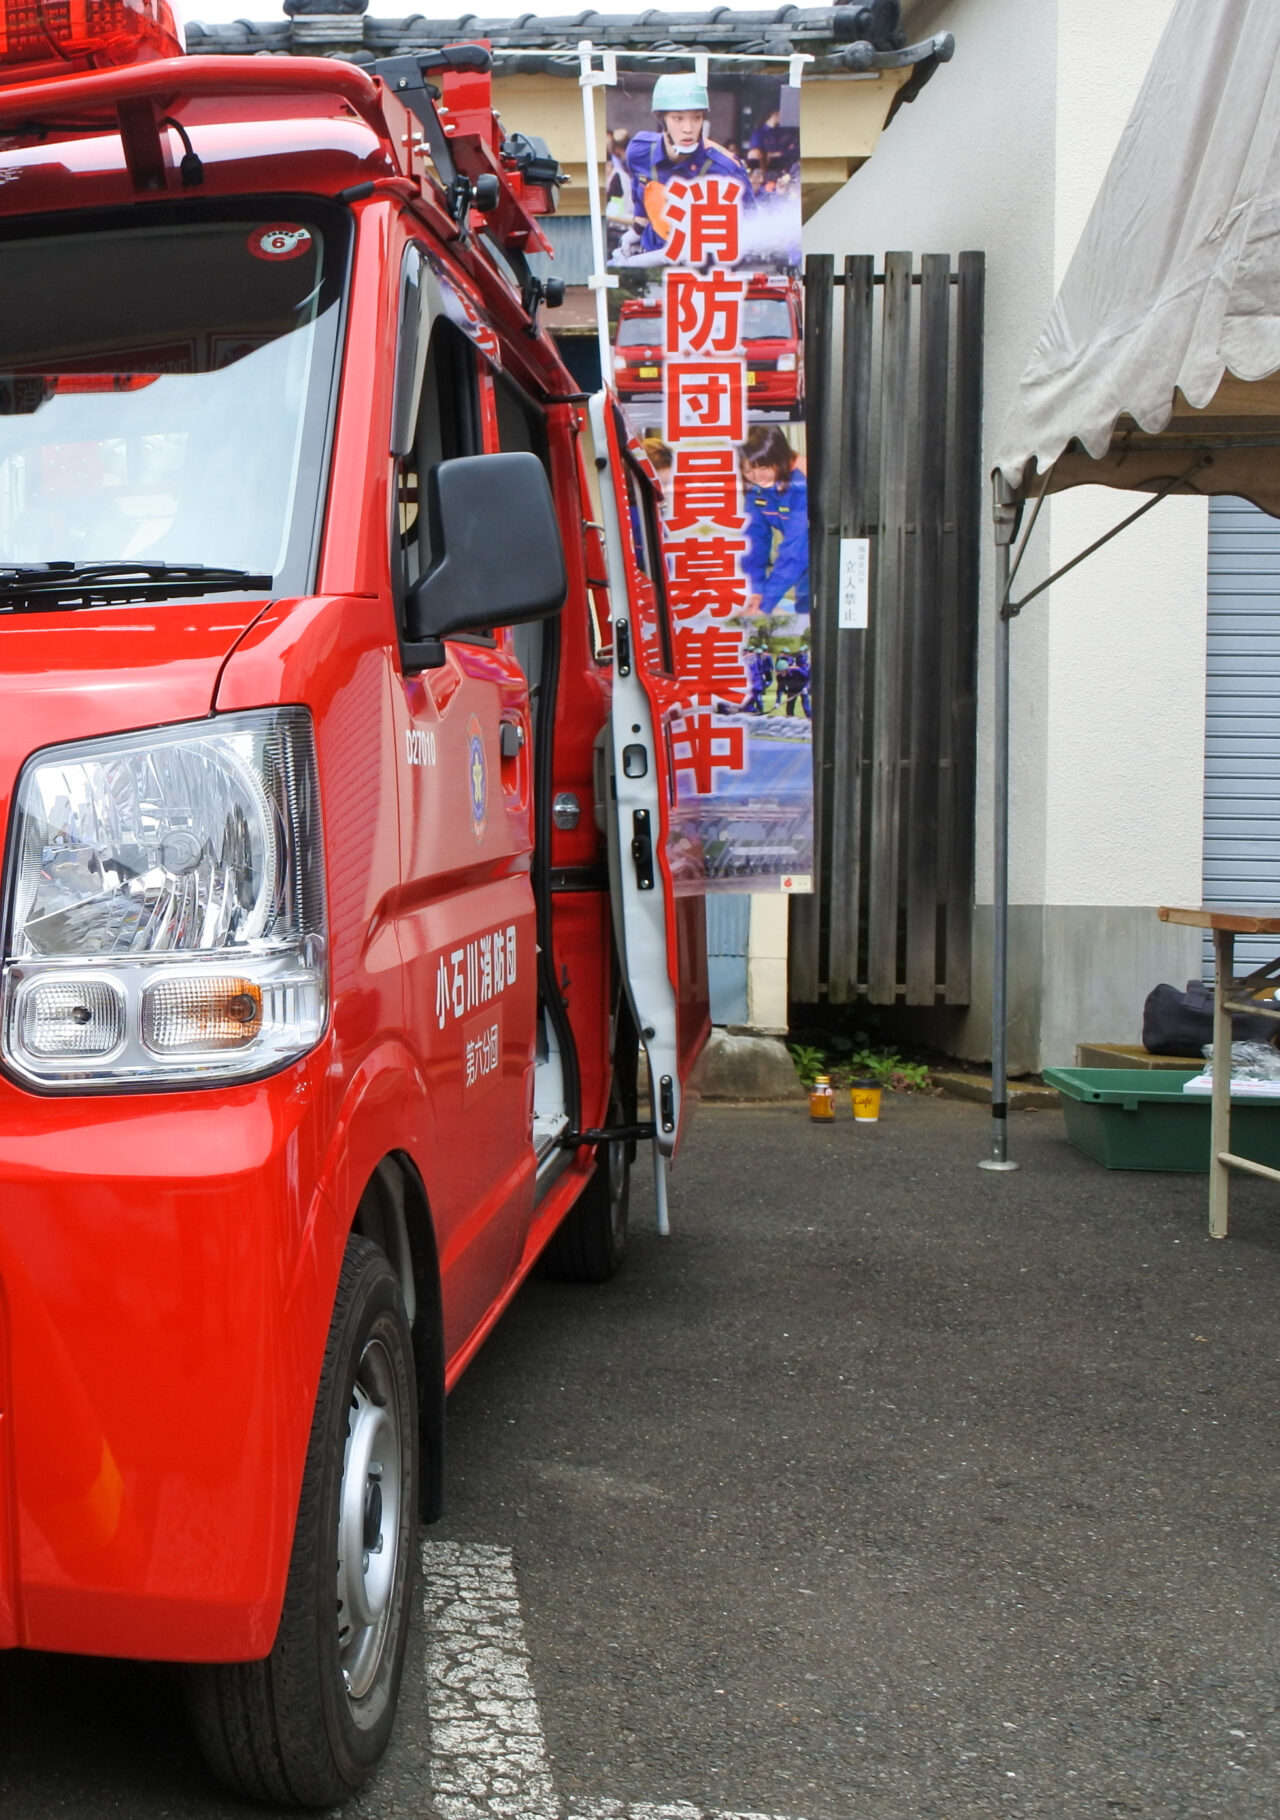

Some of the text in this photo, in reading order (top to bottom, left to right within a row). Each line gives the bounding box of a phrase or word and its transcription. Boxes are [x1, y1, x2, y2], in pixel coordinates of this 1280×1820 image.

[664, 180, 747, 795] 消防団員募集中
[436, 925, 516, 1030] 小石川消防団
[466, 1024, 498, 1088] 第六分団
